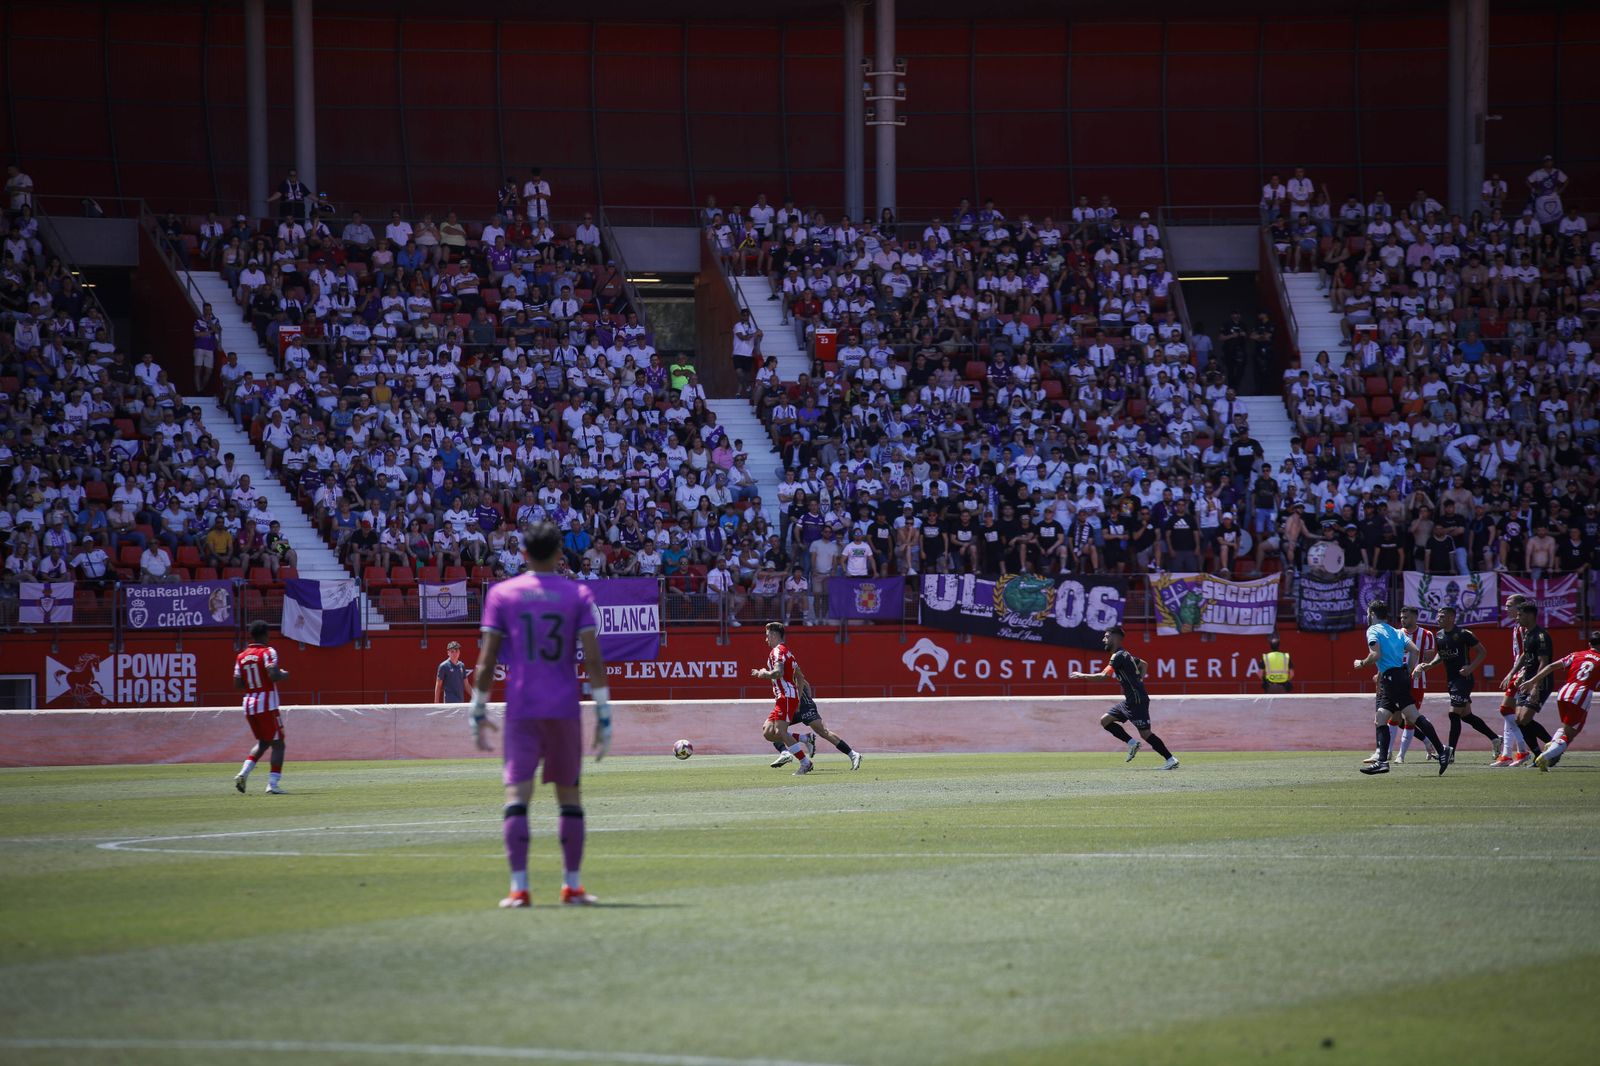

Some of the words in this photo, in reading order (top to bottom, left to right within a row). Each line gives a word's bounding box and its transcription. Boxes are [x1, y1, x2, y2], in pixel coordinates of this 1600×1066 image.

[126, 587, 157, 598] Peña
[157, 586, 183, 597] Real
[184, 585, 211, 596] Jaén
[173, 599, 188, 611] EL
[158, 611, 203, 627] CHATO
[603, 607, 657, 632] BLANCA
[518, 611, 566, 663] 13
[117, 653, 197, 678] POWER
[607, 666, 621, 675] DE
[625, 661, 737, 679] LEVANTE
[953, 659, 1058, 679] COSTA
[1067, 659, 1103, 679] DE
[1576, 660, 1595, 681] 8
[243, 663, 263, 690] 11
[117, 678, 197, 704] HORSE
